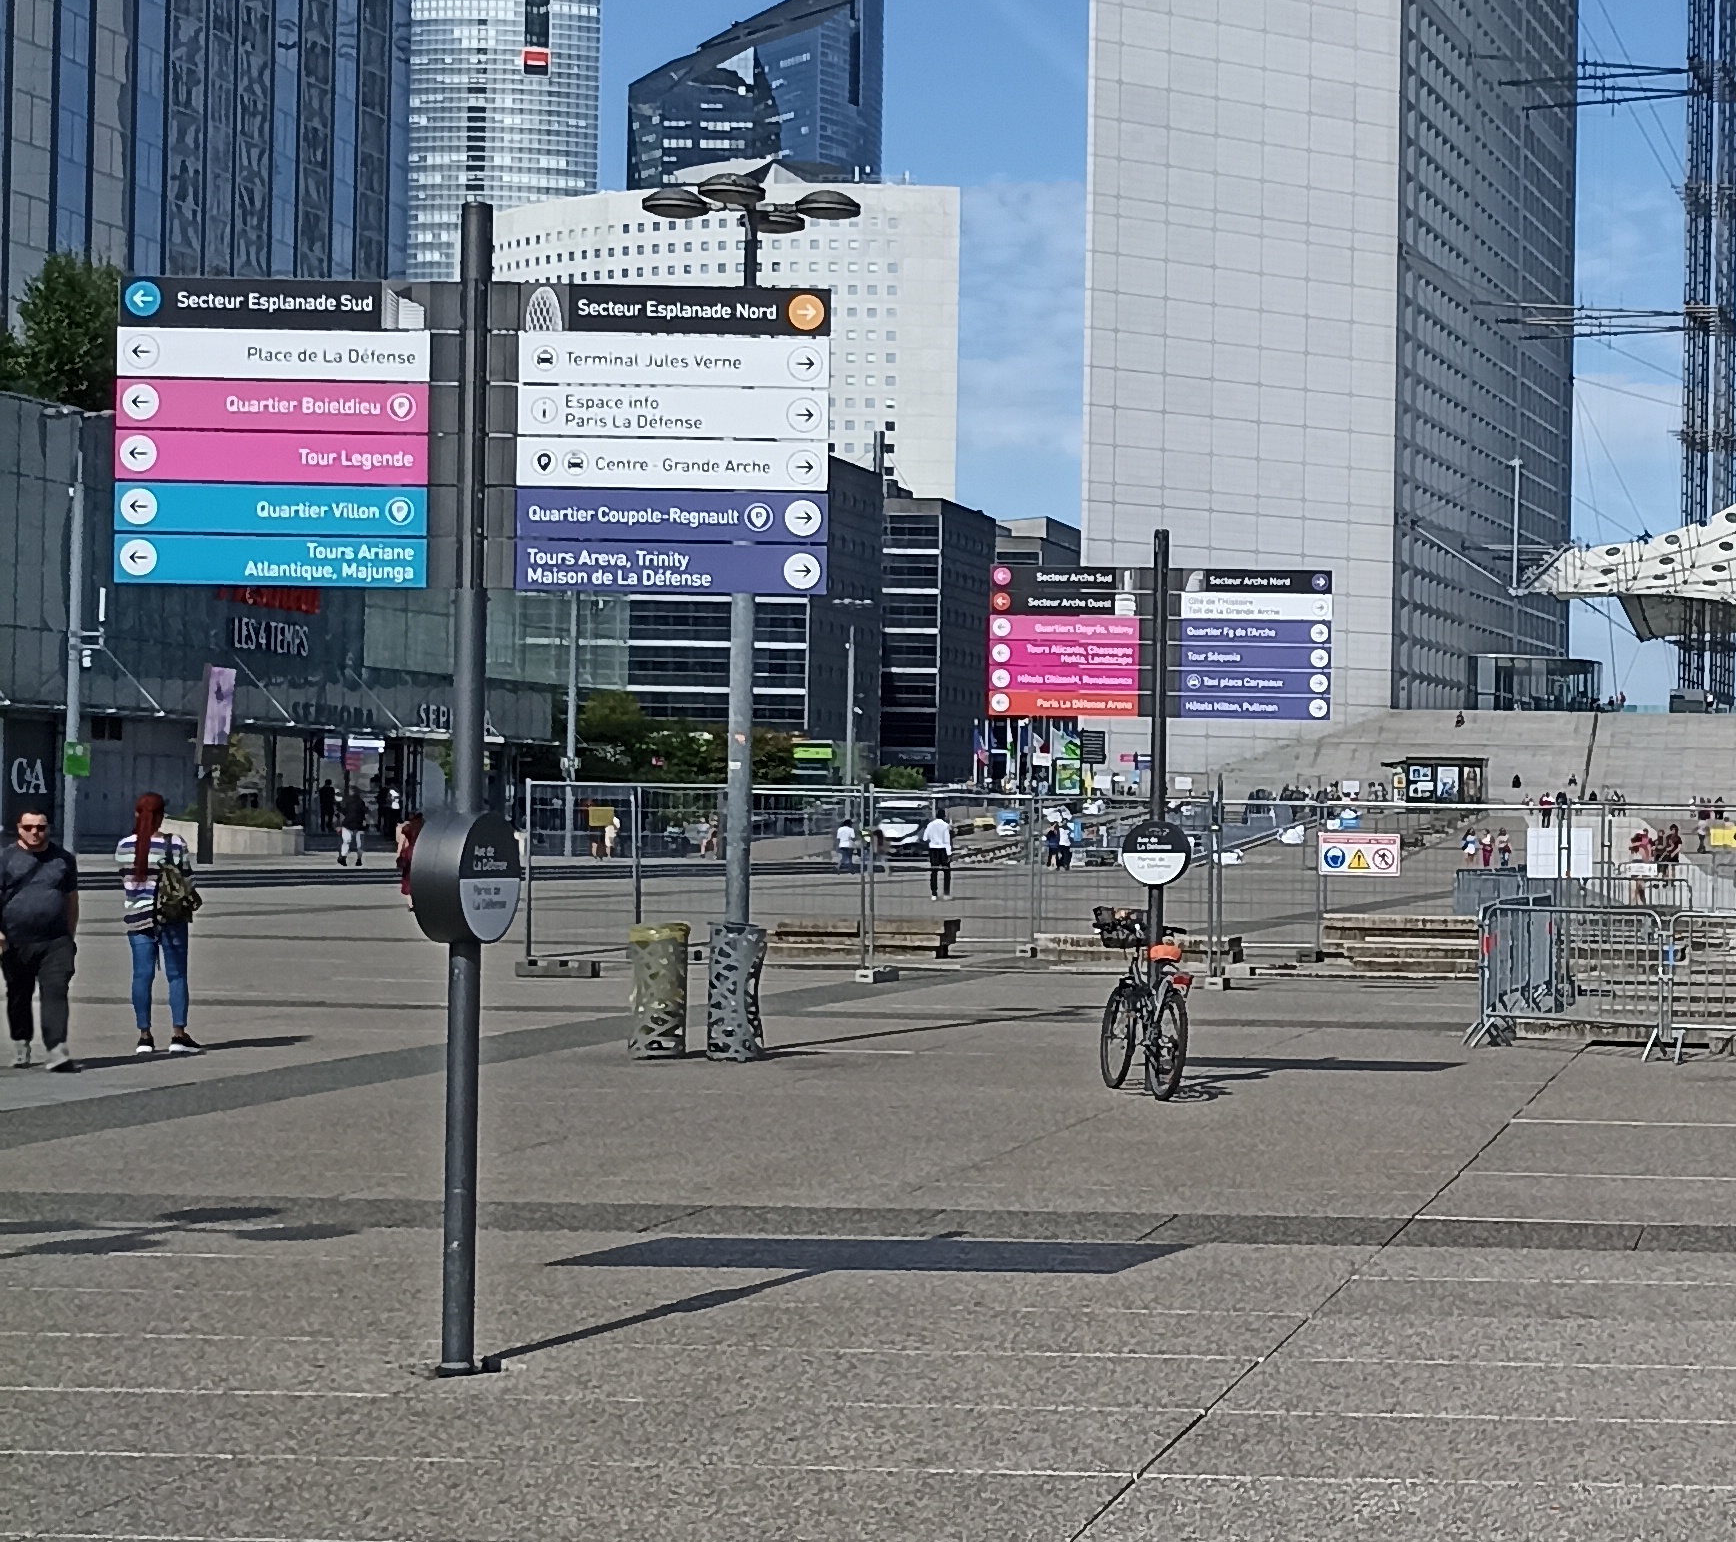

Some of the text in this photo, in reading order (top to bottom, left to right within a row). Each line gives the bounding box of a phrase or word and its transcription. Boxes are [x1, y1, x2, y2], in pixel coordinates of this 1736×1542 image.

[178, 291, 373, 315] Secteur Esplanade Sud
[578, 299, 777, 322] Secteur Esplanade Nord
[247, 346, 416, 365] Place de La Défense
[566, 351, 742, 370] Terminal Jules Verne
[226, 395, 381, 415] Quartier Boieldieu
[565, 394, 659, 412] Espace info
[565, 413, 703, 430] Paris La Défense
[299, 448, 414, 470] Tour Legende
[596, 456, 648, 471] Centre
[662, 457, 720, 473] Grande
[725, 458, 771, 474] Arche
[257, 501, 380, 520] Quartier Villon
[528, 505, 739, 527] Quartier Coupole-Regnault
[307, 543, 414, 561] Tours Ariane
[527, 548, 689, 571] Tours Areva, Trinity
[244, 562, 414, 583] Atlantique, Majunga
[527, 568, 712, 587] Maison de La Défense
[1037, 572, 1112, 582] Secteur Arche Sud
[1210, 576, 1290, 586] Secteur Arche Nord
[1028, 598, 1112, 607] Secteur Arche Ouest
[234, 617, 308, 657] LES 4 TEMPS
[1187, 627, 1222, 636] Quartier
[1223, 627, 1234, 638] Fg
[1236, 628, 1246, 637] de
[1188, 652, 1206, 661] Tour
[1203, 677, 1218, 686] Taxi
[1220, 677, 1242, 688] place
[1037, 698, 1059, 707] Paris
[1060, 699, 1071, 708] La
[419, 704, 500, 736] SEPA
